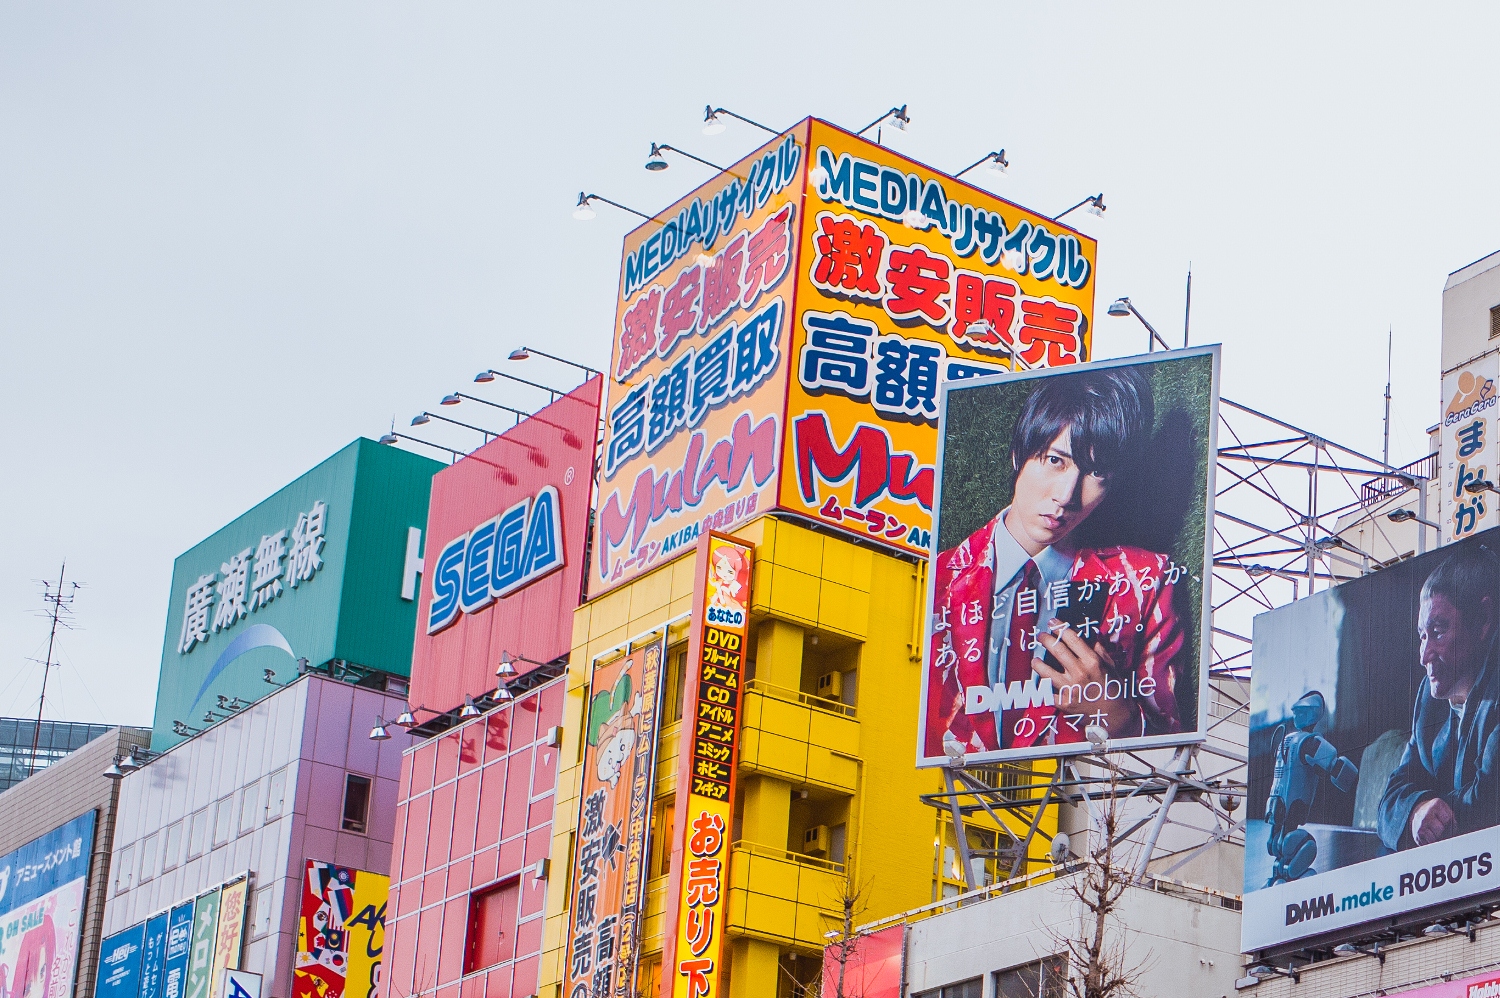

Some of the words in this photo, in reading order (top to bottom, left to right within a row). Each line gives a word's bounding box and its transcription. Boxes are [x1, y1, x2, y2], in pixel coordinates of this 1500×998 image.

[616, 201, 796, 383] 激安販売
[812, 213, 1086, 369] 激安販売
[605, 294, 783, 480] 高額買取
[1444, 396, 1497, 428] GeraGera
[1452, 417, 1487, 539] まんが
[598, 411, 779, 585] Mulan
[427, 485, 565, 636] SEGA
[706, 629, 741, 652] DVD
[704, 647, 740, 668] ブルーレイ
[702, 665, 739, 689] ゲーム
[706, 685, 730, 704] CD
[965, 676, 1056, 718] DMM
[1058, 673, 1157, 710] mobile
[697, 721, 733, 743] アニメ
[1013, 708, 1110, 740] のスマホ
[697, 741, 731, 762] コミック
[696, 759, 728, 780] ホビー
[1398, 852, 1493, 897] ROBOTS
